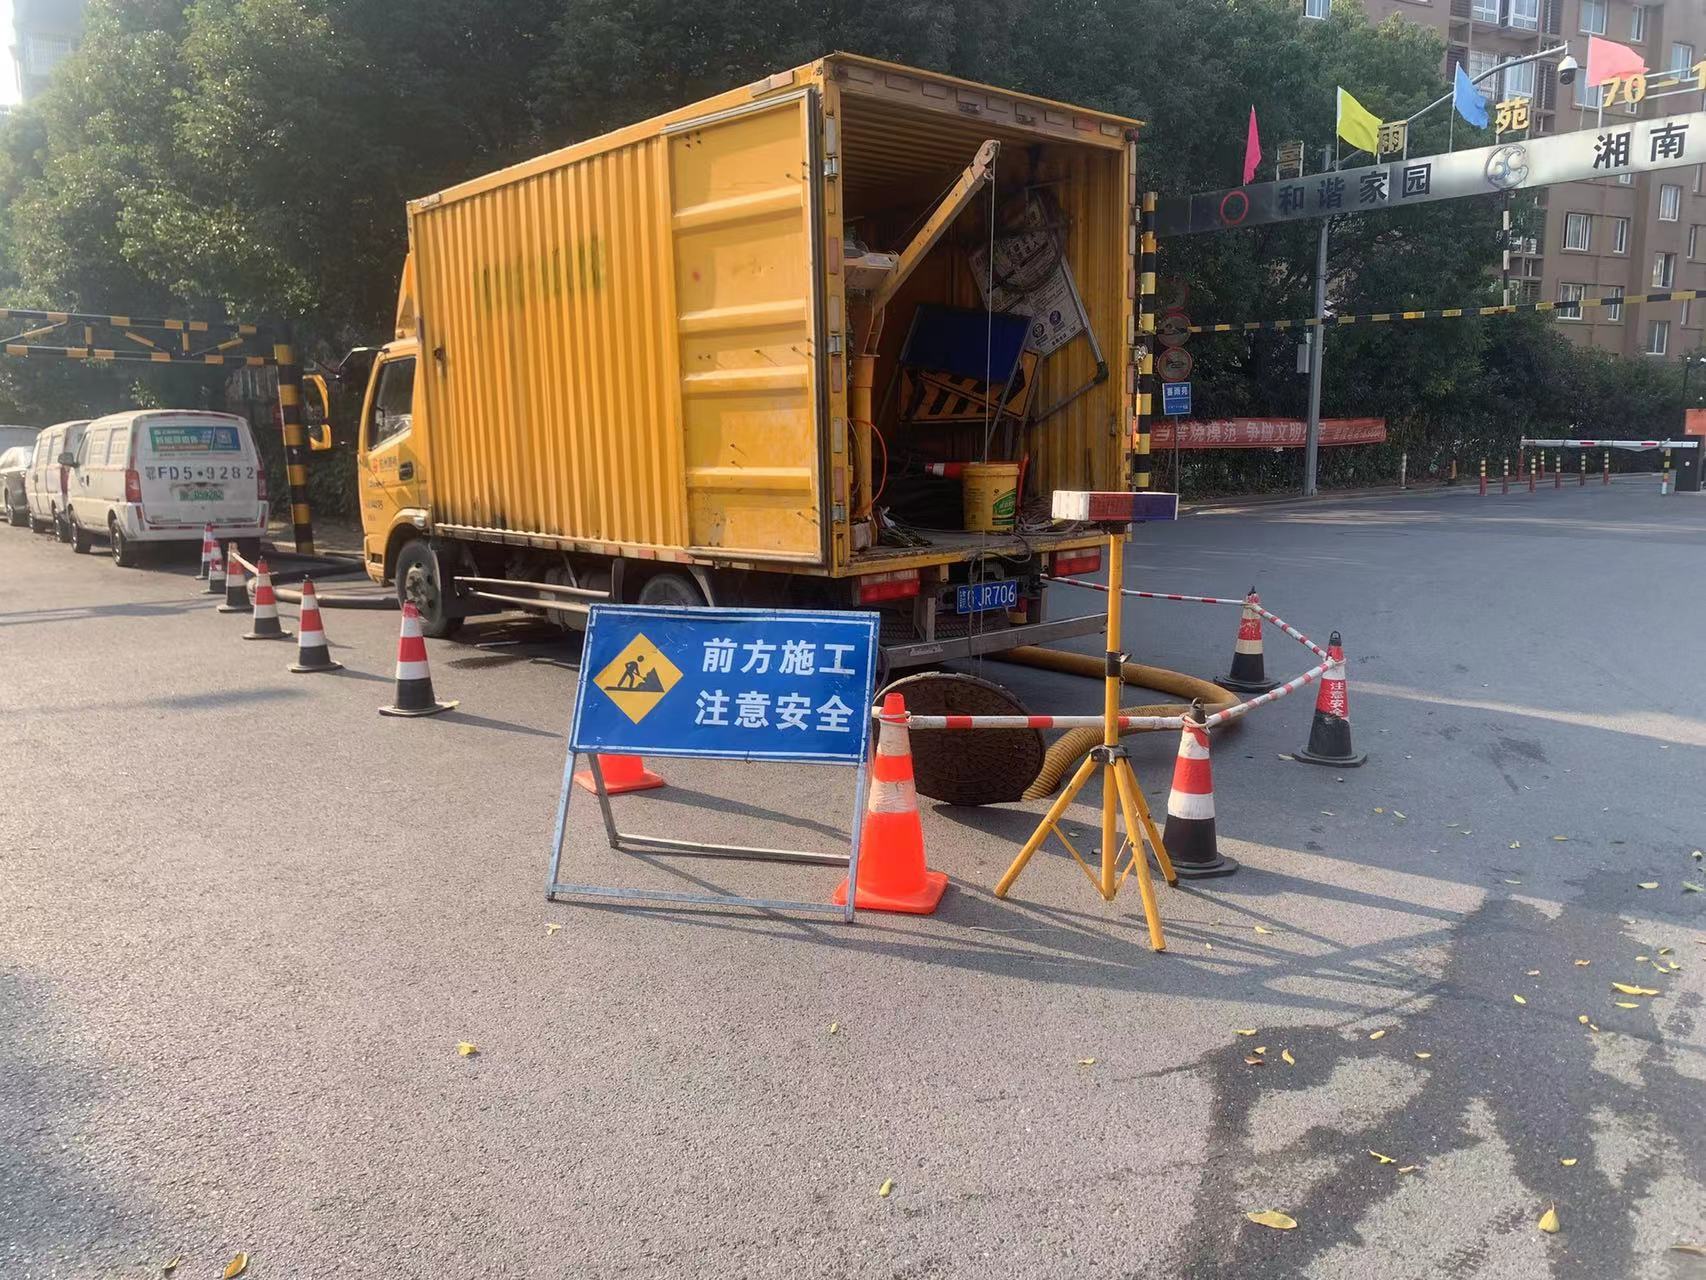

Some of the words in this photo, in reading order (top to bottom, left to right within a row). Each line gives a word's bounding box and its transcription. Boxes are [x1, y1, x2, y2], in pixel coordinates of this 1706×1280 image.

[1593, 123, 1689, 169] 湘南
[1278, 163, 1432, 214] 和谐家园
[703, 637, 856, 676] 前方施工
[694, 689, 855, 733] 注意安全
[1330, 682, 1345, 717] 注意安全
